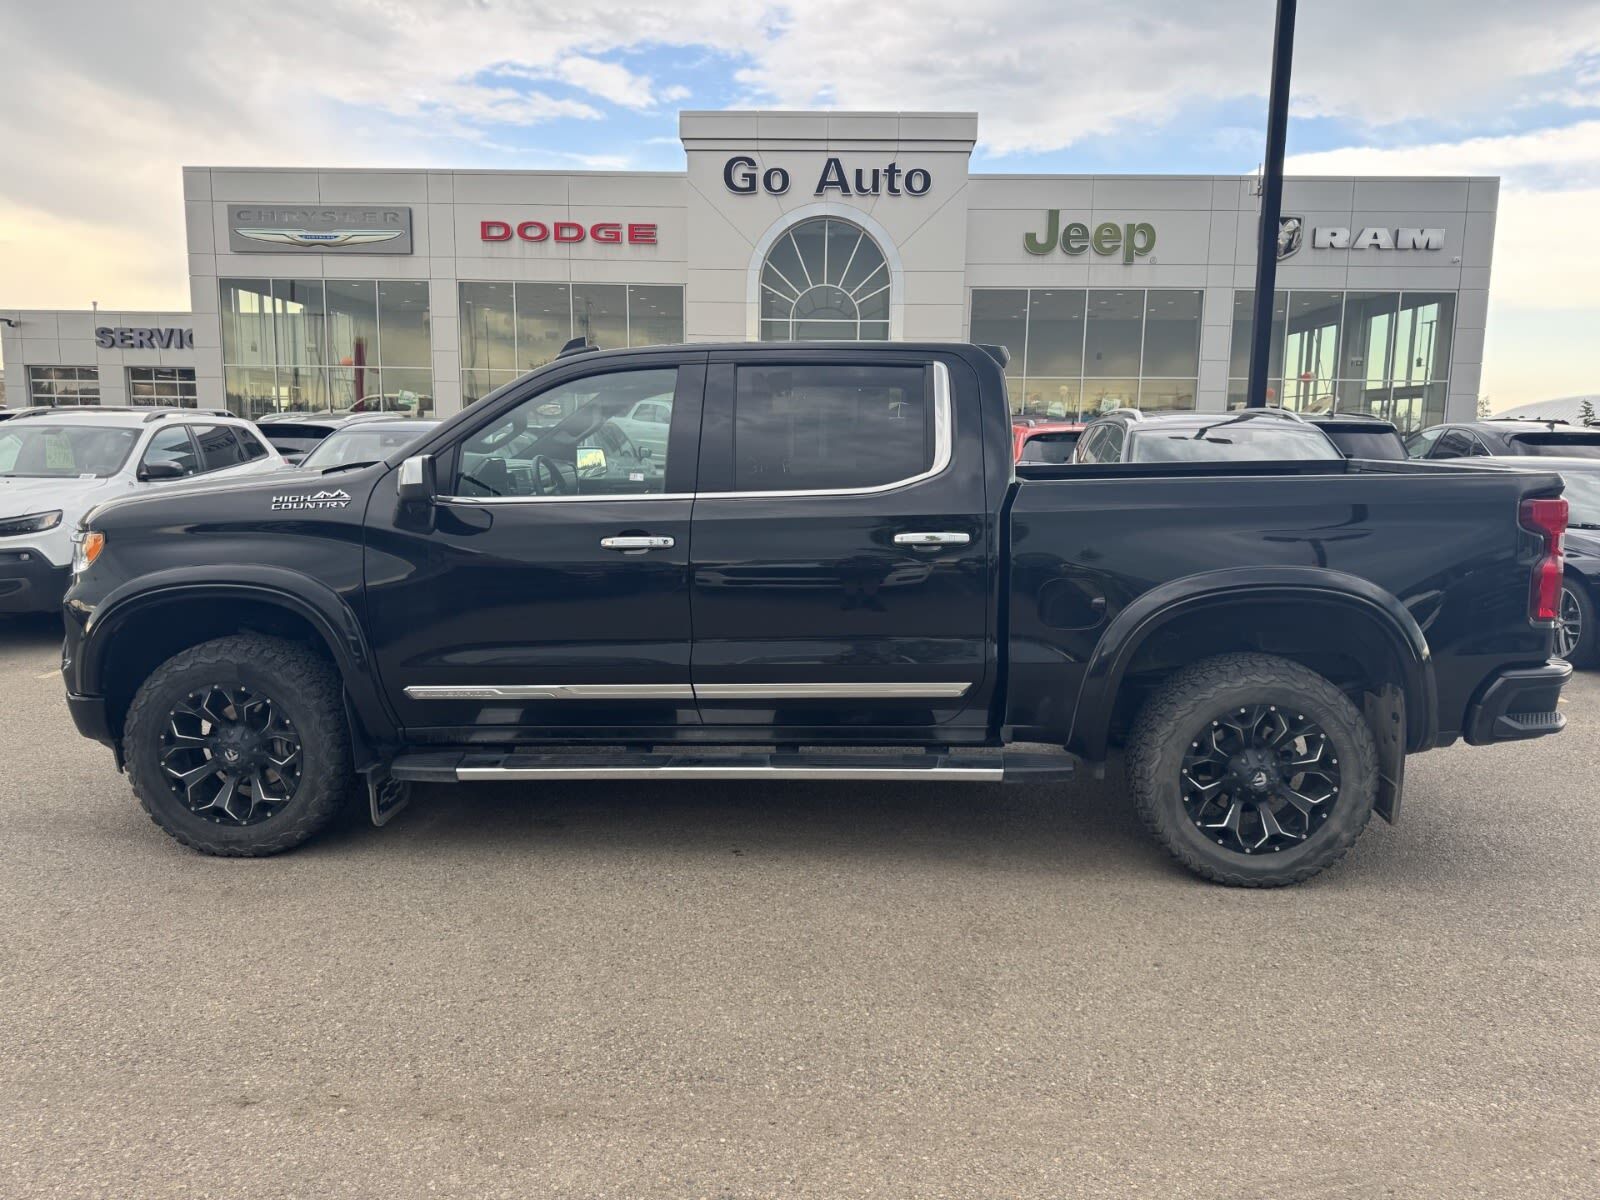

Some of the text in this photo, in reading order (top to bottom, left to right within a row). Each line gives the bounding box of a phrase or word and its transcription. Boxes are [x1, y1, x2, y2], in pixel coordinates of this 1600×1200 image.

[723, 156, 931, 196] Go Auto
[236, 209, 400, 224] CHRYSLER
[480, 221, 657, 244] DODGE
[1024, 209, 1156, 264] Jeep
[1313, 227, 1446, 250] RAM
[271, 501, 348, 510] COUNTRY
